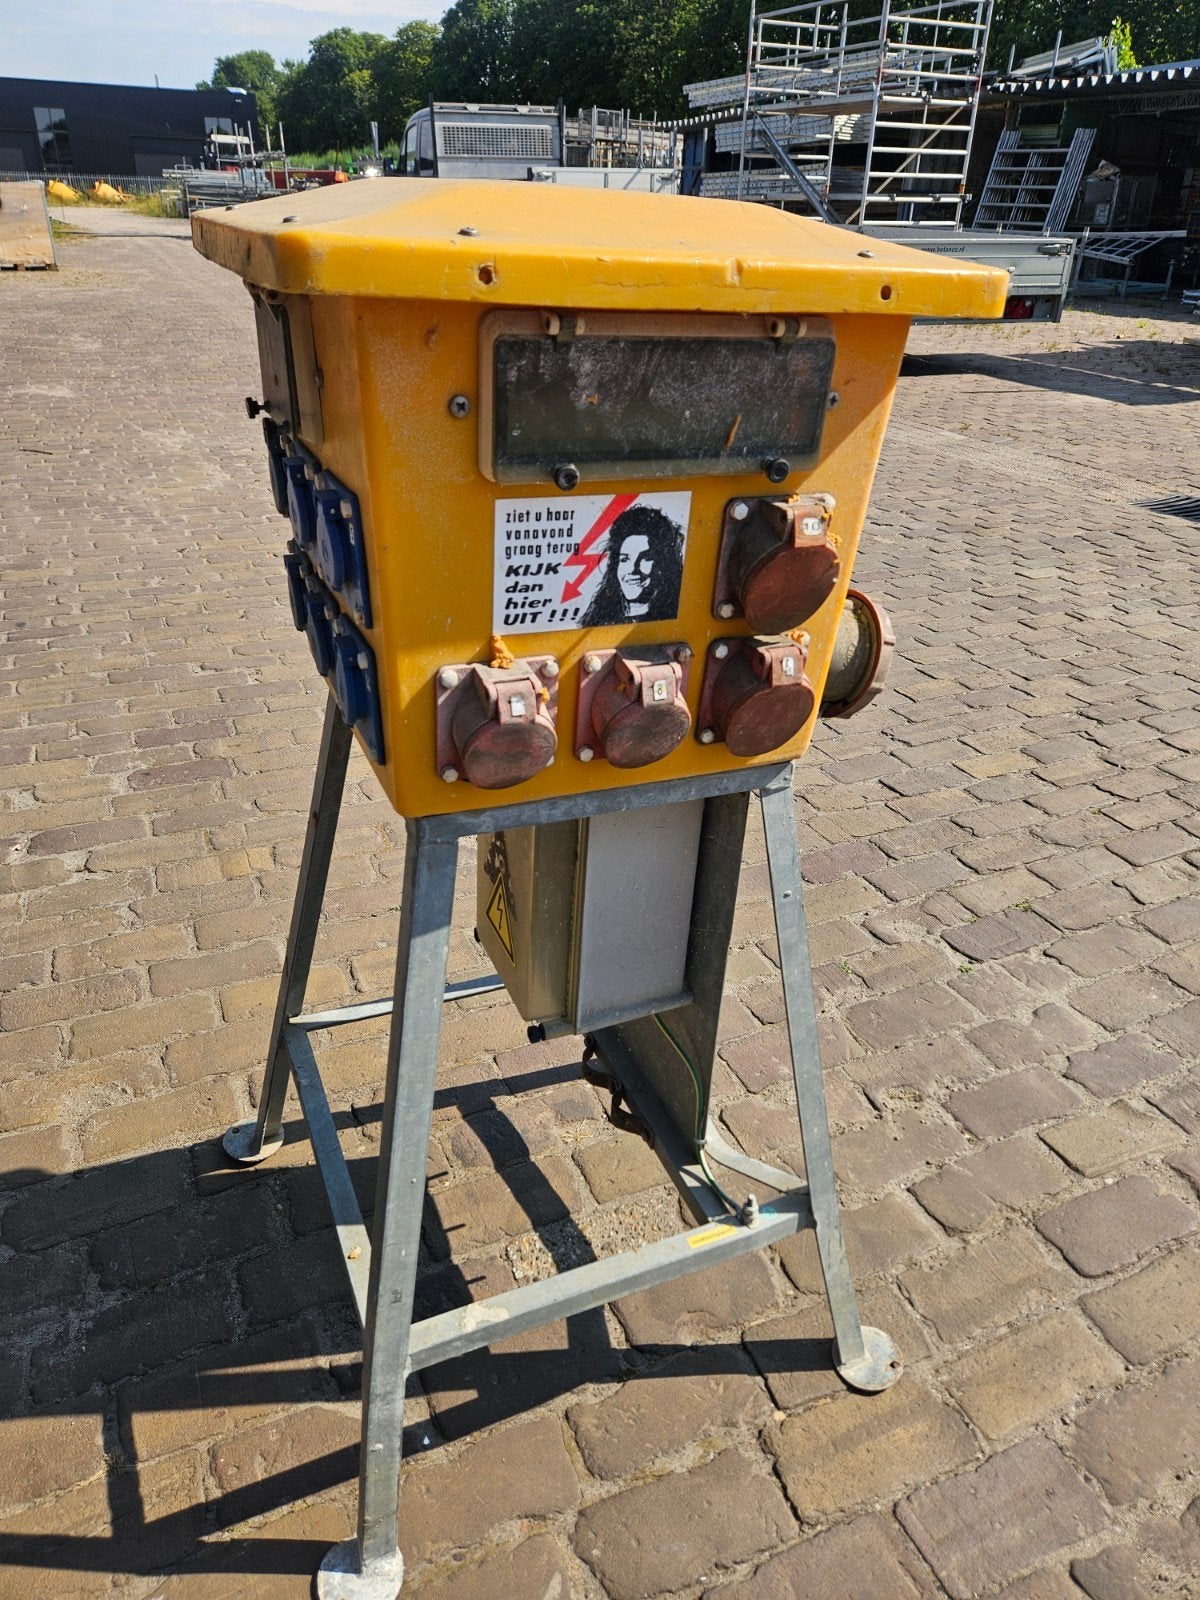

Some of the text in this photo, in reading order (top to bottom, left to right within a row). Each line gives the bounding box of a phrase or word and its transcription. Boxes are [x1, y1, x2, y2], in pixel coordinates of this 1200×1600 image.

[506, 507, 575, 523] ziet u haar
[506, 524, 573, 540] vanavond
[505, 542, 580, 560] graag terug
[505, 563, 562, 577] KIJK
[505, 581, 544, 593] dan
[505, 596, 552, 610] hier
[503, 611, 542, 625] UIT
[657, 683, 663, 696] 8
